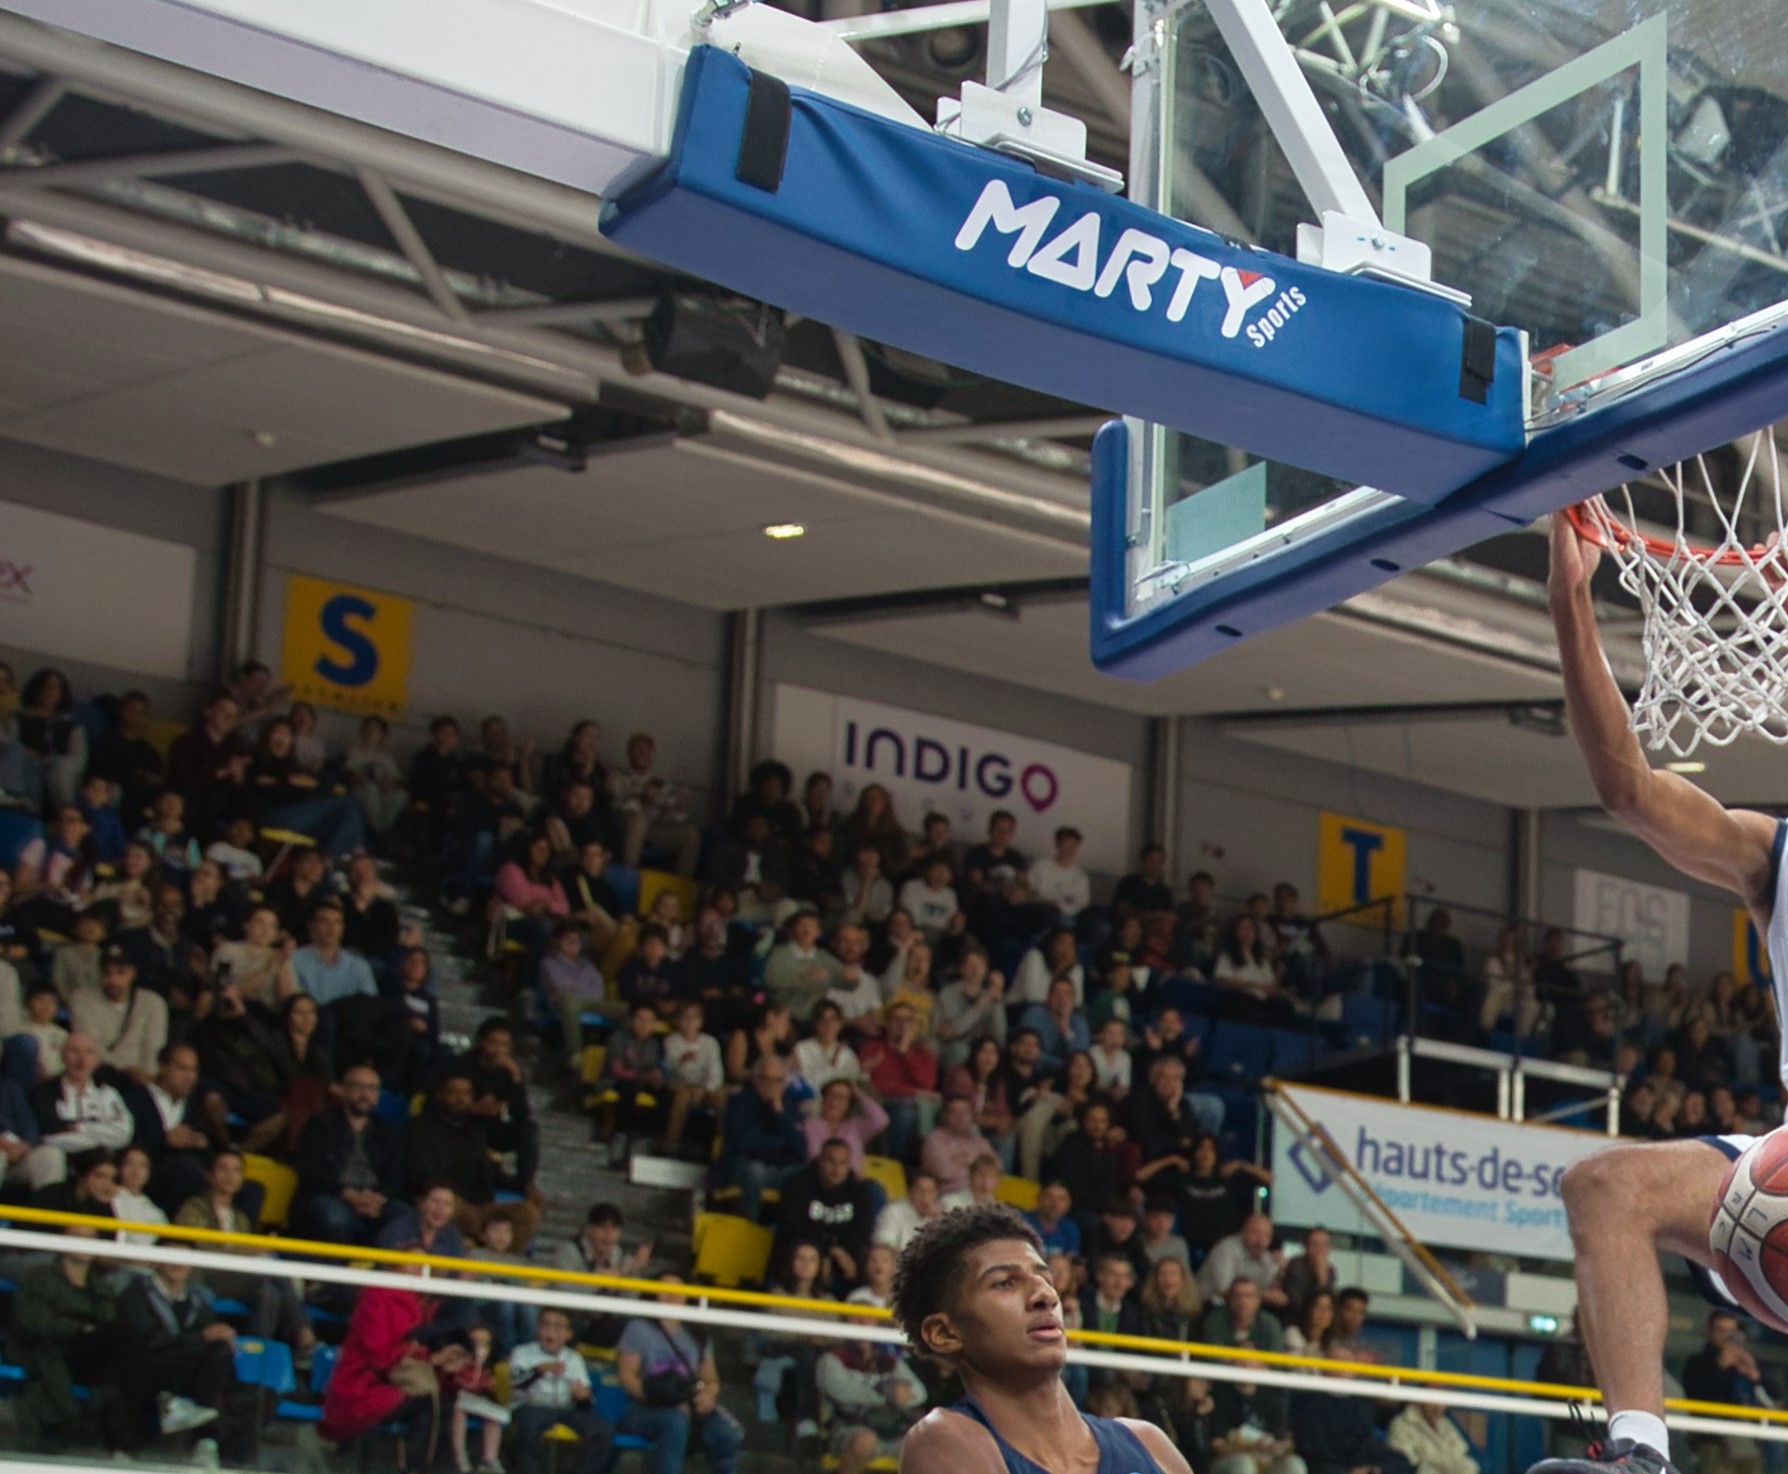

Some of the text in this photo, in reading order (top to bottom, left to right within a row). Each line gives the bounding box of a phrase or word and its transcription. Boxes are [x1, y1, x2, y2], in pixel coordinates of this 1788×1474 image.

[955, 179, 1276, 338] MARTY
[1246, 286, 1307, 348] Sports
[315, 593, 377, 687] S
[846, 721, 1058, 812] INDIGO
[1342, 826, 1384, 905] T
